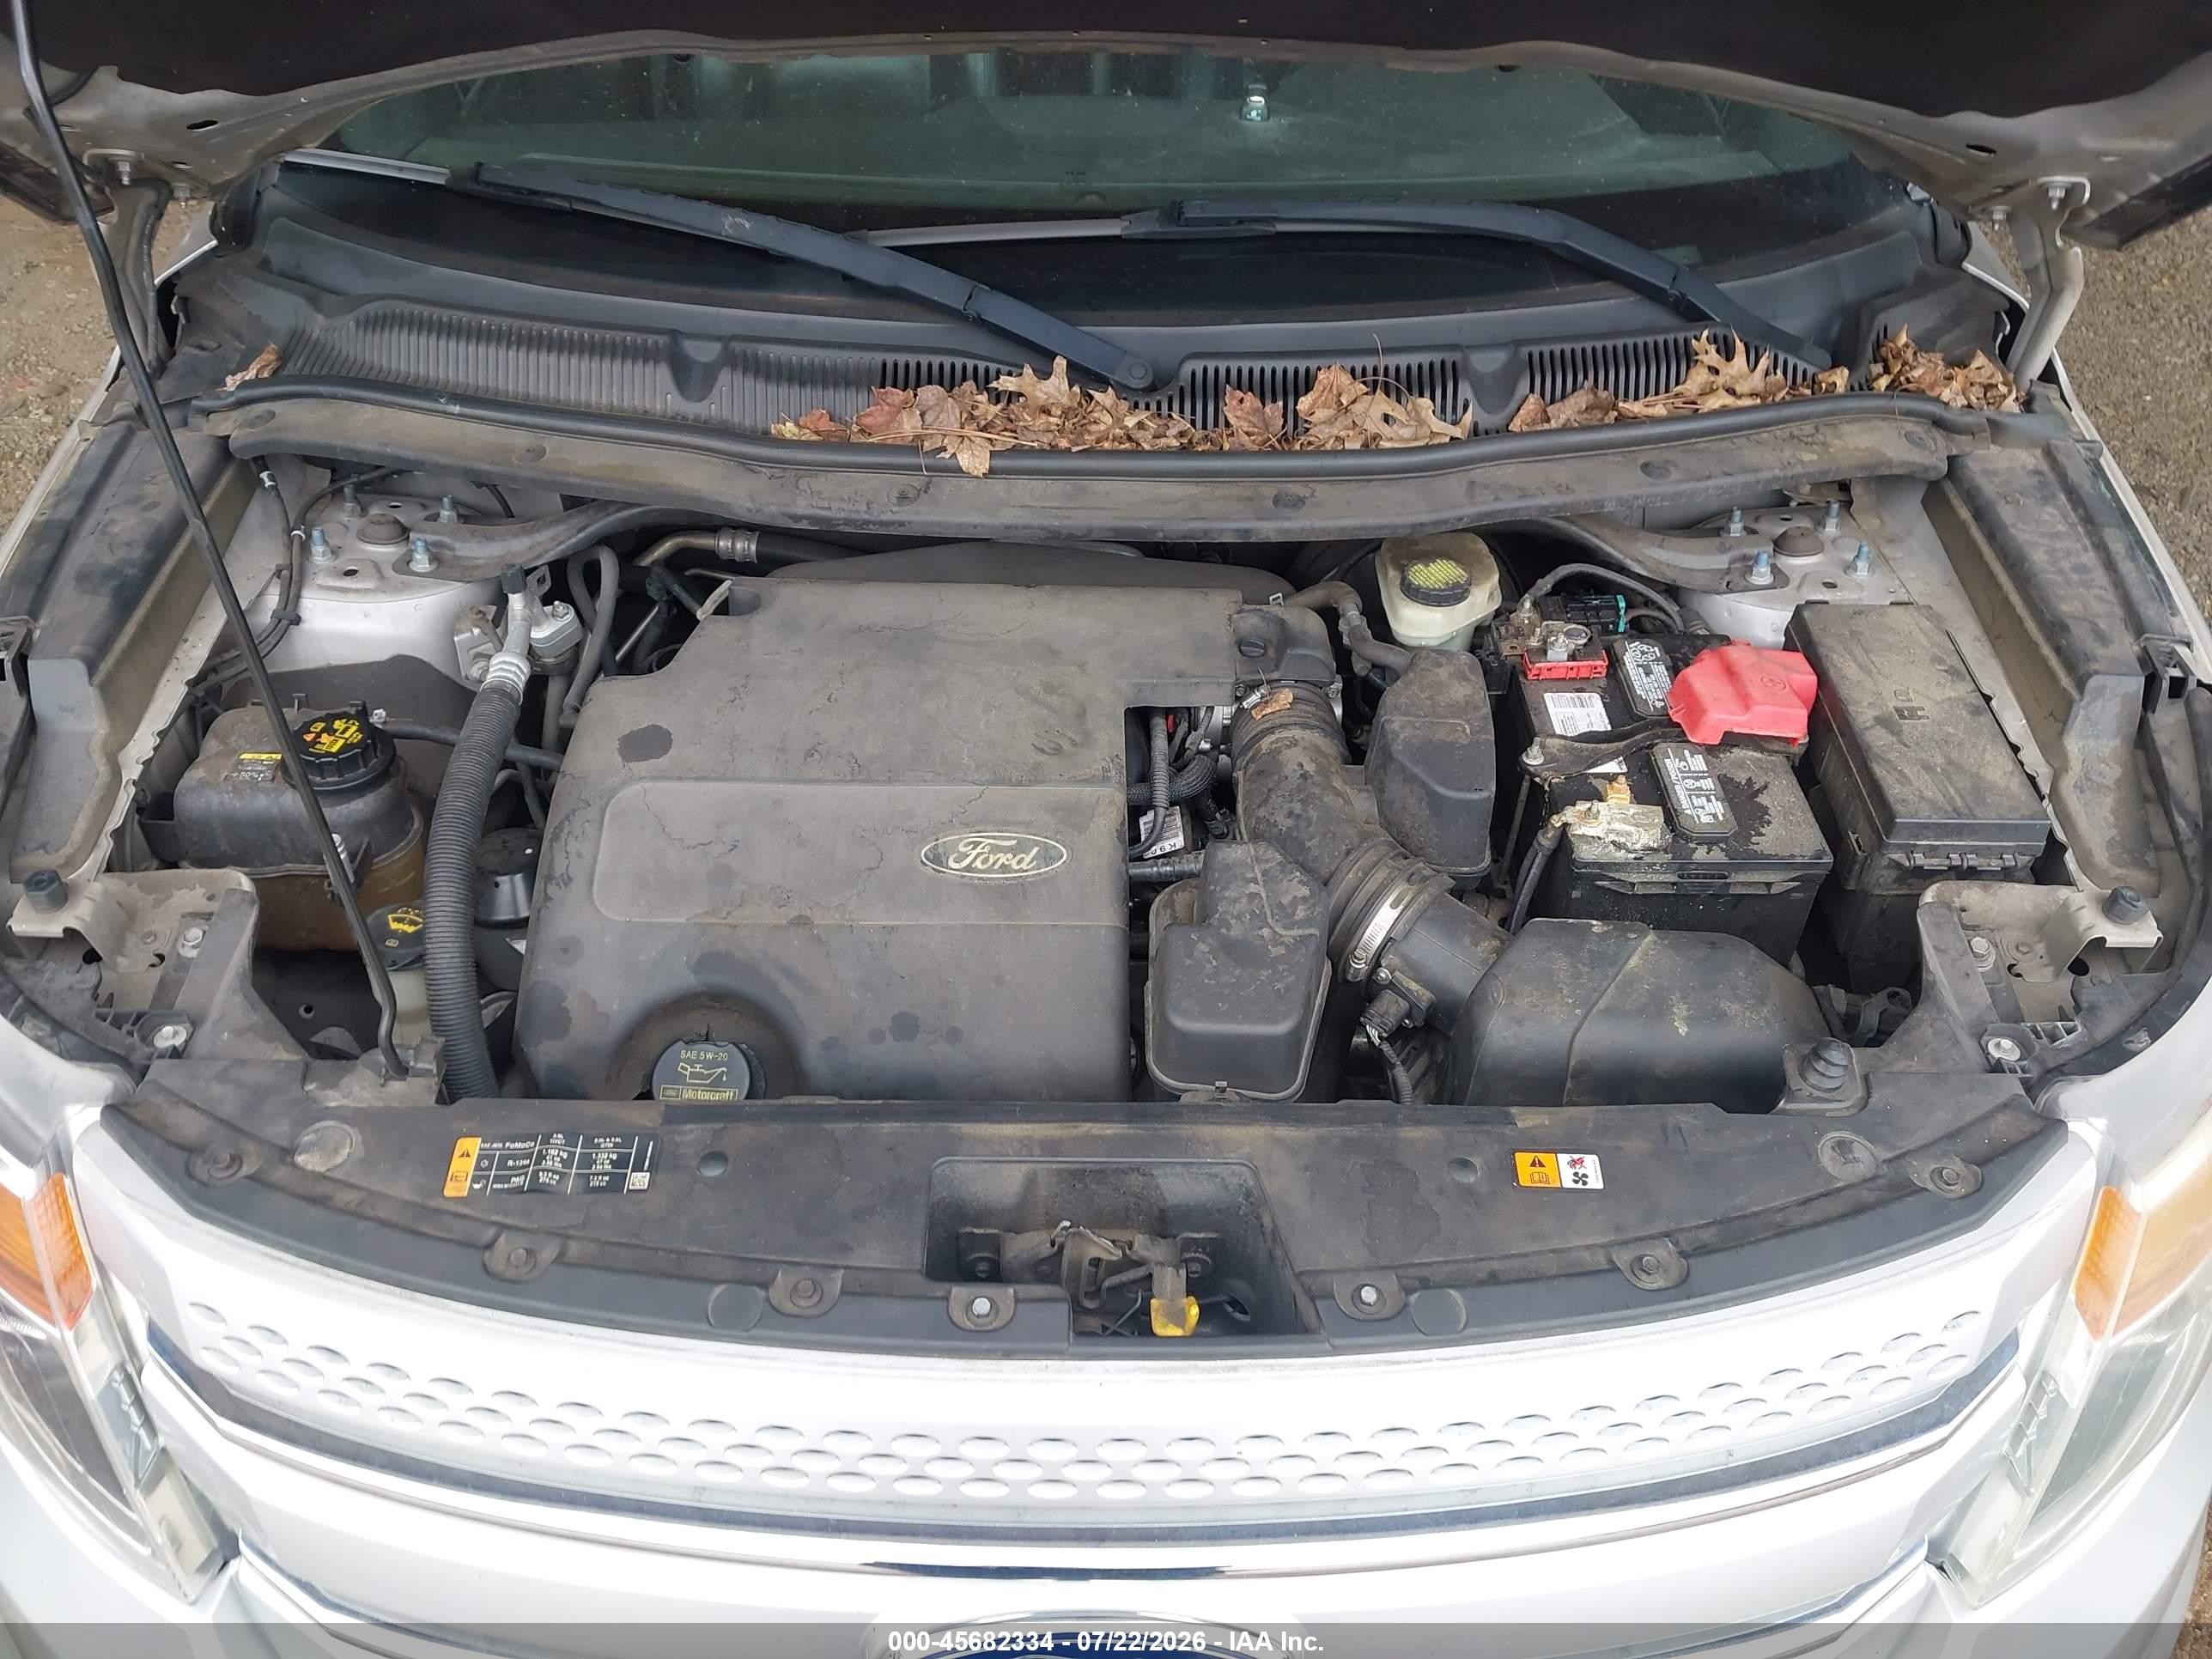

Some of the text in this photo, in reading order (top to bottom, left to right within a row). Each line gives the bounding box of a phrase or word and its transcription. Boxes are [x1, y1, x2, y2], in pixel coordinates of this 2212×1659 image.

[948, 837, 1040, 870] Ford
[680, 1049, 728, 1061] SAE 5W-20
[682, 1088, 733, 1099] Motorcraft
[505, 1140, 536, 1149] FoMoCo
